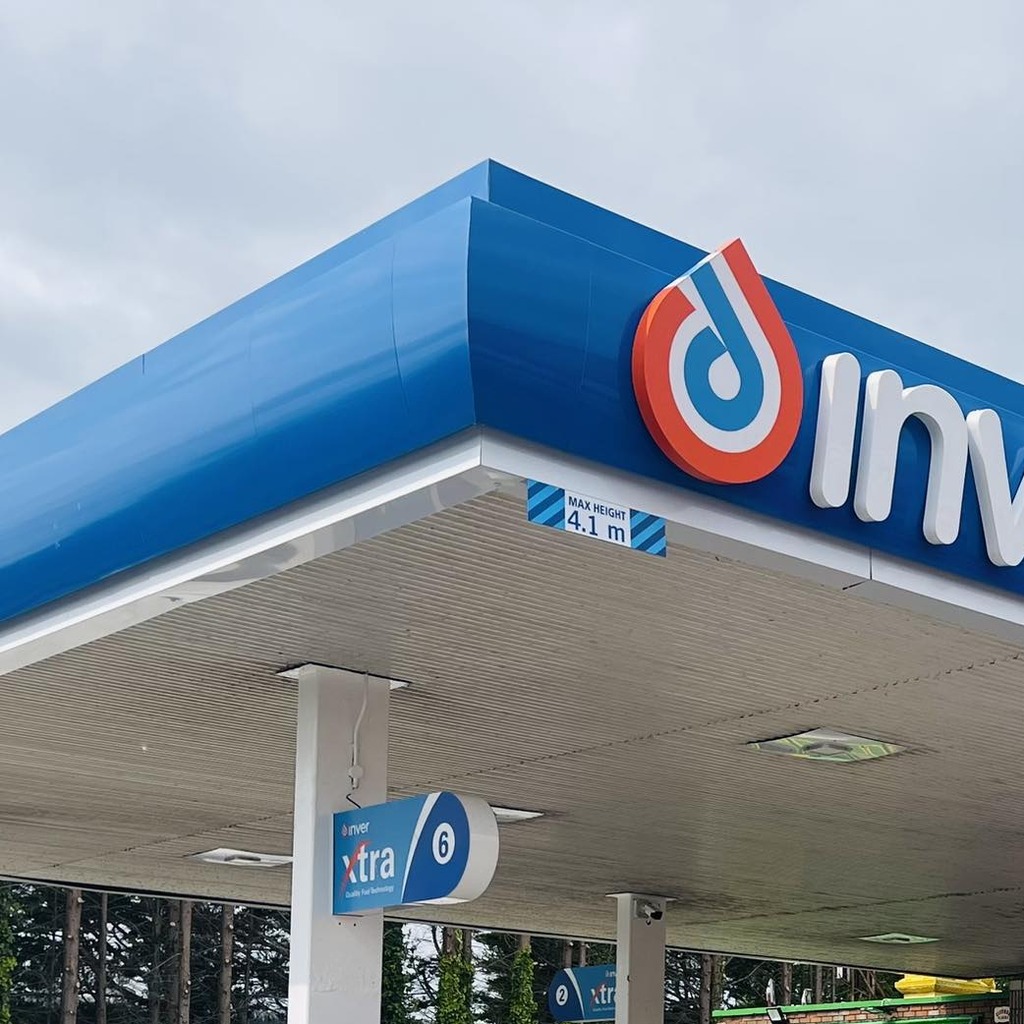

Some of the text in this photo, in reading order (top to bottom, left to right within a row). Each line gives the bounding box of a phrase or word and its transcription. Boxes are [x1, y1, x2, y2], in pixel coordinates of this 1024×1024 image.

[568, 496, 626, 520] MAX HEIGHT
[567, 510, 625, 542] 4.1 m
[348, 821, 370, 836] inver
[438, 831, 449, 858] 6
[341, 843, 395, 884] xtra
[559, 989, 565, 1002] 2
[591, 984, 616, 1005] xtr
